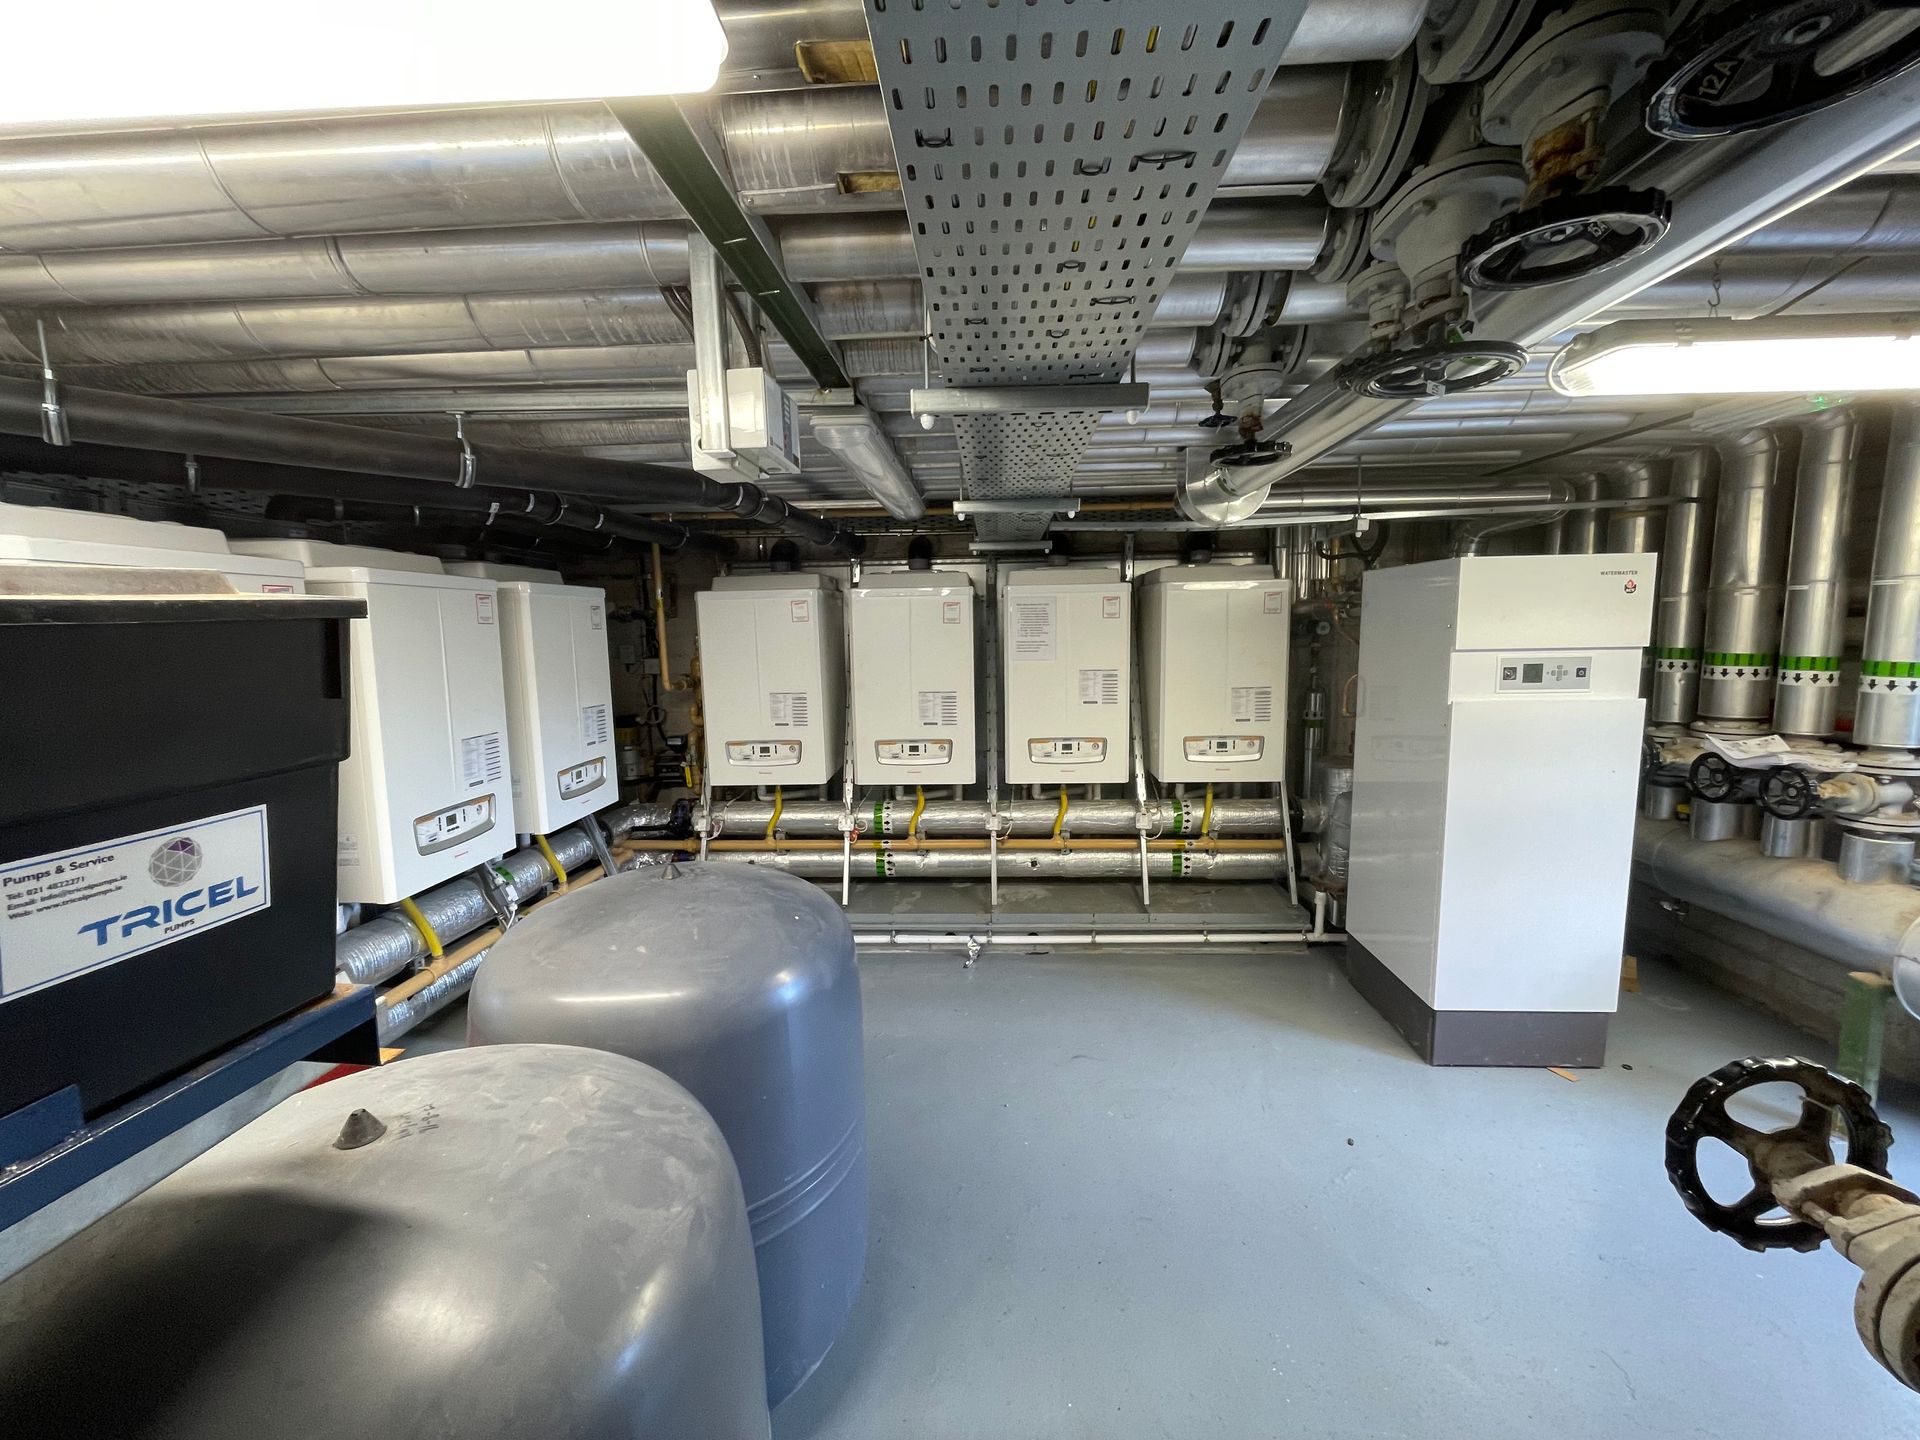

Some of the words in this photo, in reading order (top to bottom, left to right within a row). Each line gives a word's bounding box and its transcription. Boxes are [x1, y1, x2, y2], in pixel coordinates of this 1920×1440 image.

[1698, 60, 1738, 98] 12A
[3, 869, 51, 887] Pumps
[55, 865, 65, 875] &
[69, 854, 115, 871] Service
[6, 891, 24, 901] Tel:
[26, 886, 43, 896] 021
[7, 898, 37, 911] Email:
[77, 875, 260, 946] TRICEL
[8, 909, 33, 920] Web:
[164, 918, 196, 934] PUMPS
